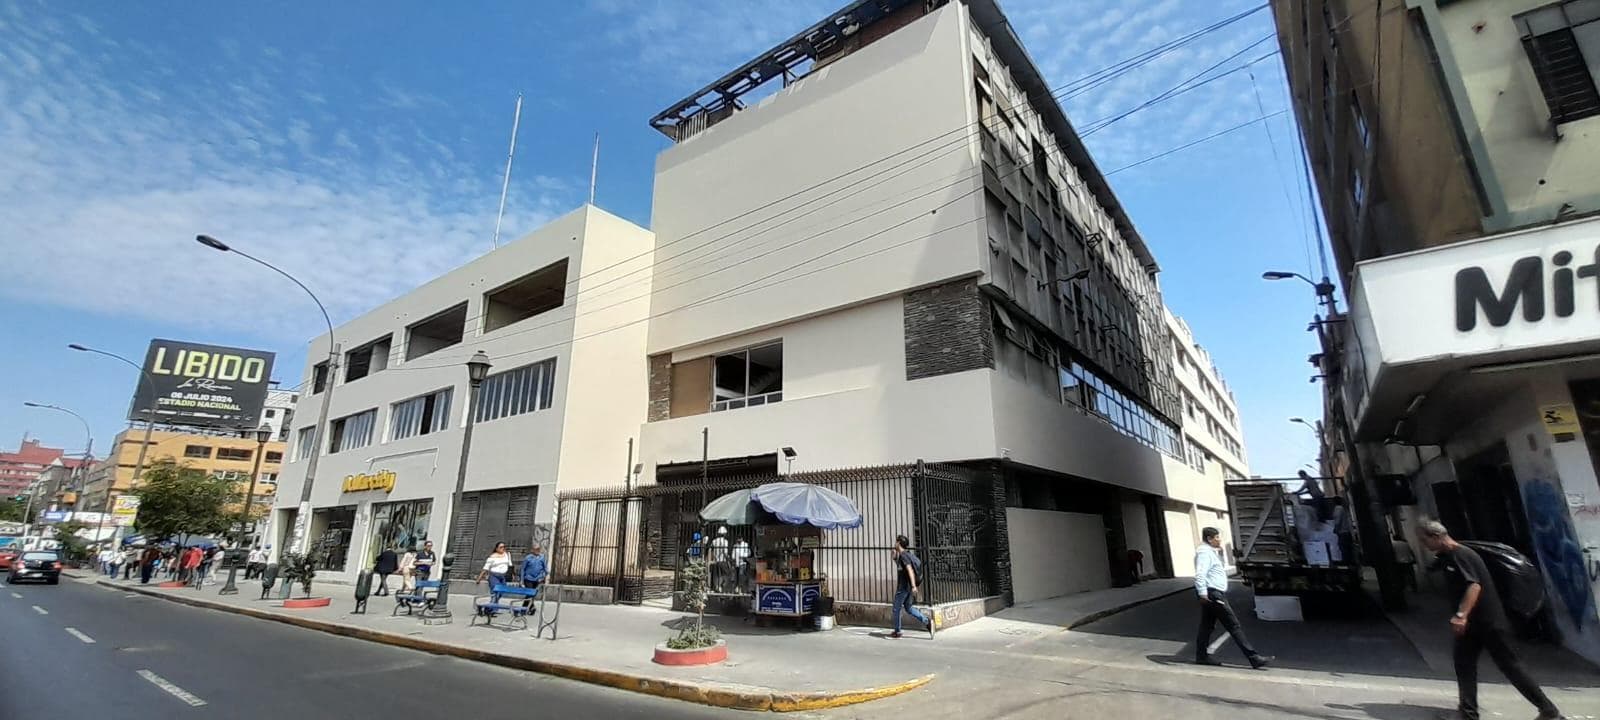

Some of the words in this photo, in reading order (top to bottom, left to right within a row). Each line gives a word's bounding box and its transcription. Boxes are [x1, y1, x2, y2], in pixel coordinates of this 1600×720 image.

[152, 347, 265, 383] LIBIDO
[158, 397, 196, 407] ESTADIO
[197, 400, 241, 411] NACIONAL
[183, 393, 210, 401] JULIO
[210, 395, 233, 403] 2024
